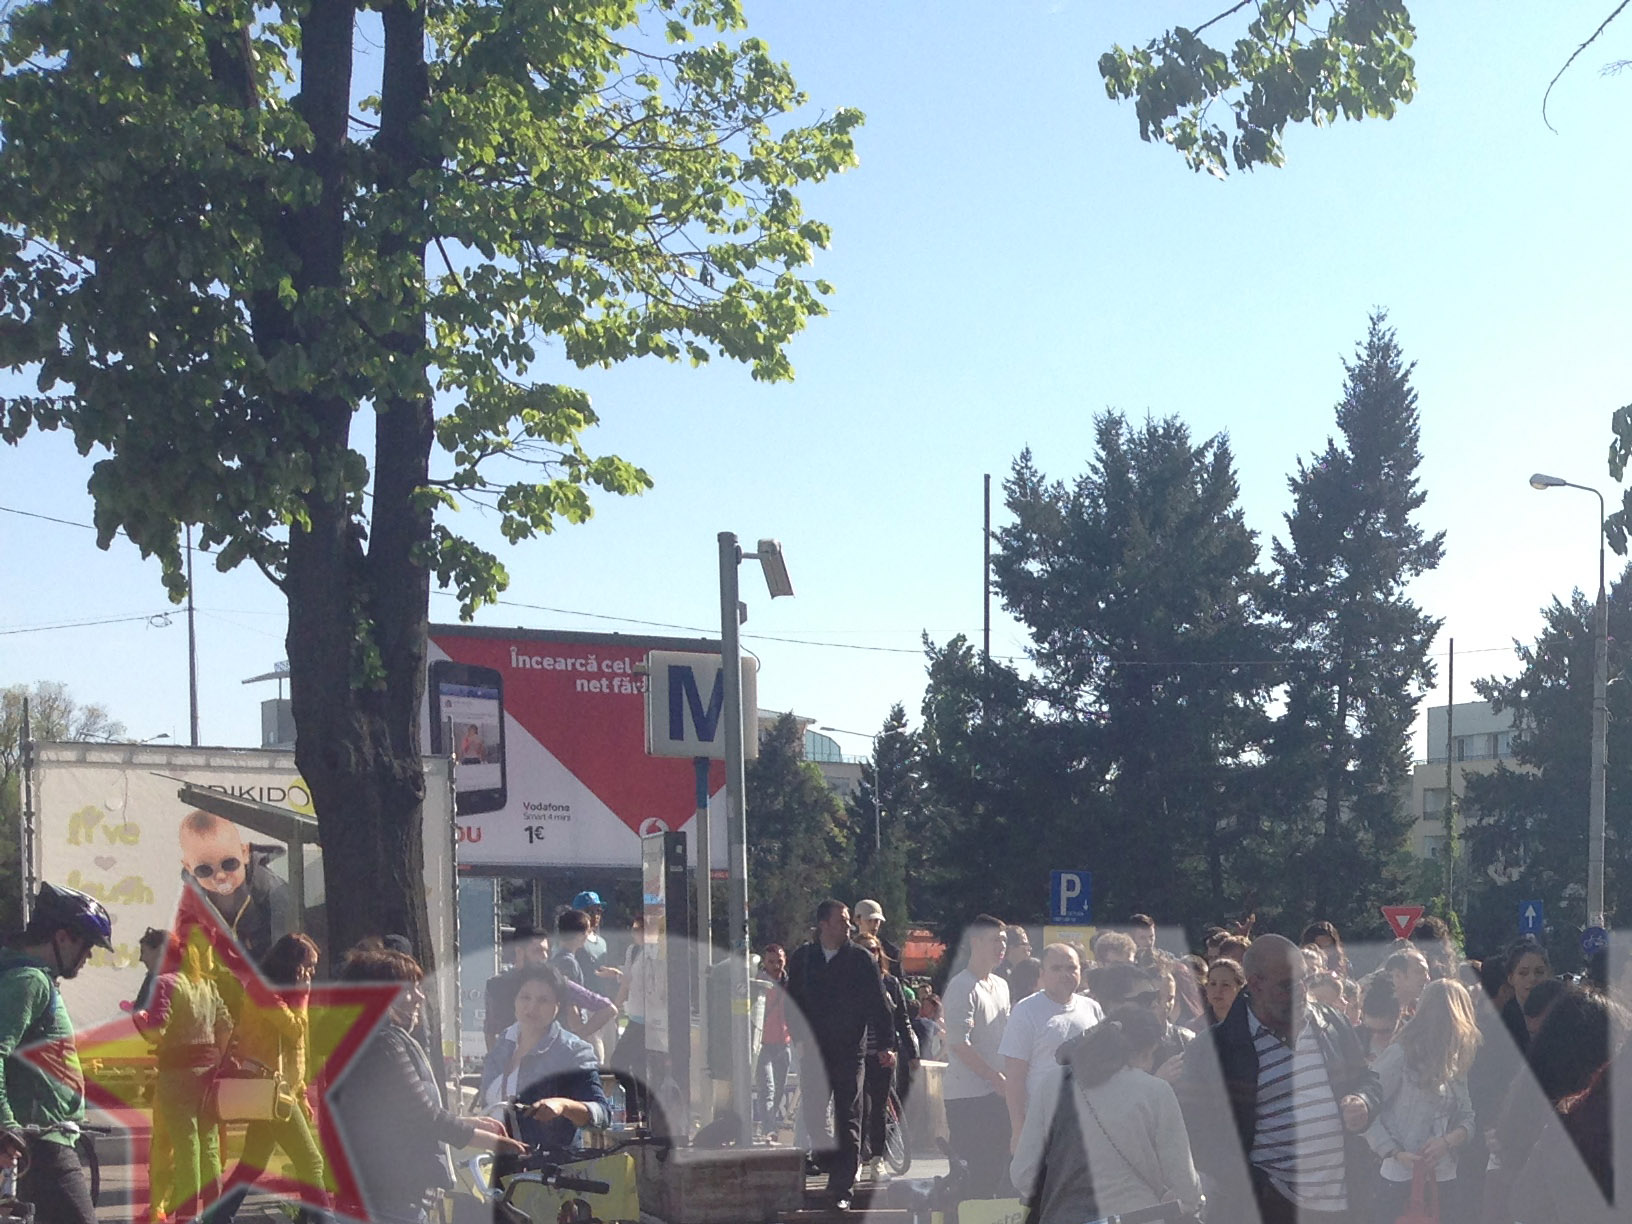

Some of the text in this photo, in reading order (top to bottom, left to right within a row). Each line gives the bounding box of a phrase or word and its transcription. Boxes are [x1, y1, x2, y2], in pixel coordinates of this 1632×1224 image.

[510, 646, 598, 672] Încearcă
[602, 657, 632, 673] cel
[576, 677, 609, 693] net
[668, 665, 725, 742] M
[523, 802, 570, 812] Vodafone
[524, 826, 544, 844] 1€
[1061, 873, 1081, 916] P
